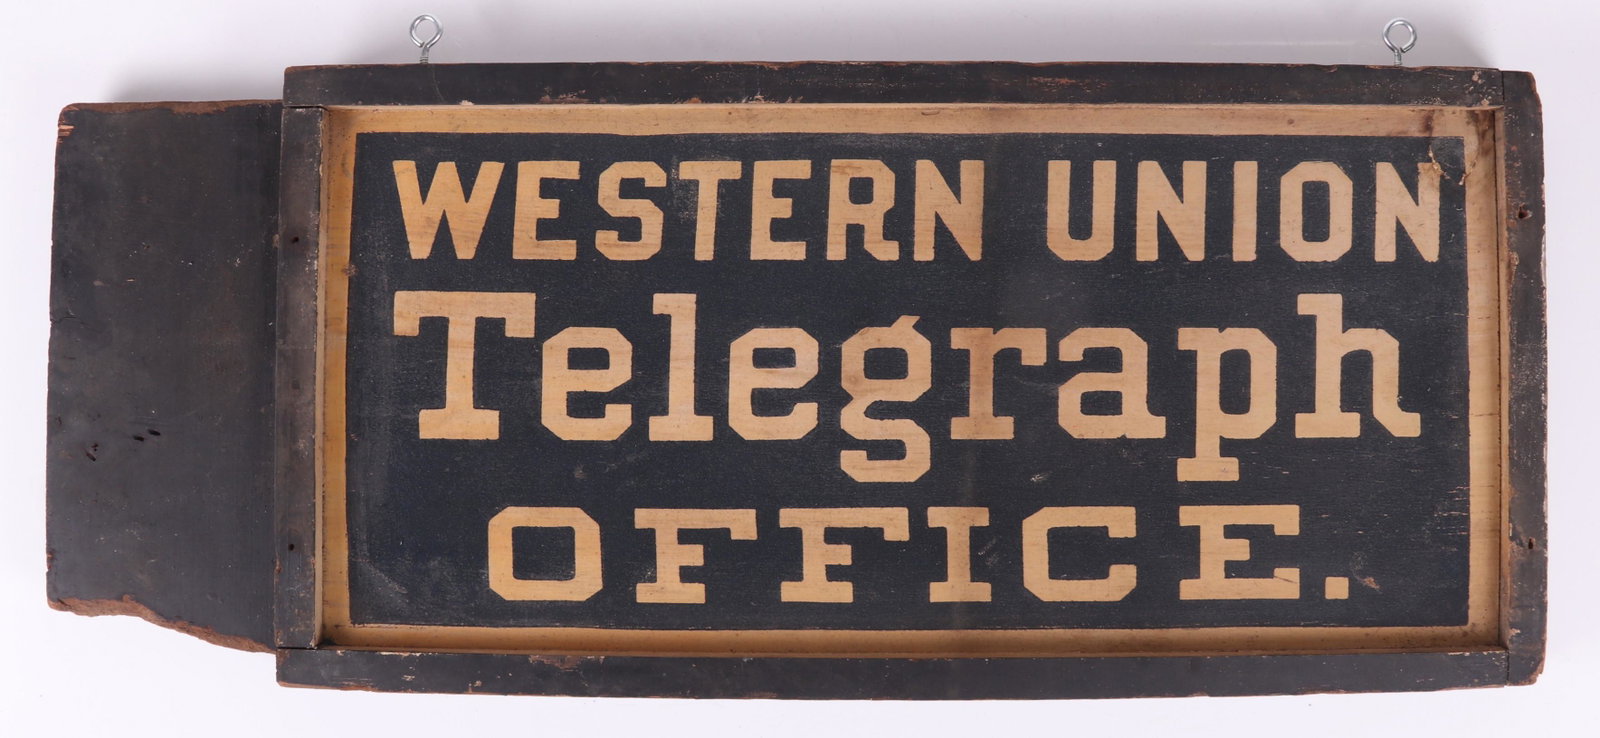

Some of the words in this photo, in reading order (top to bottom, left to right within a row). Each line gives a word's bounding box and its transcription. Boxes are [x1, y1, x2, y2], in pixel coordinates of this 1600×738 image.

[393, 160, 985, 261] WESTERN
[1047, 160, 1442, 262] UNION
[393, 291, 1421, 482] Telegraph
[488, 505, 1350, 603] OFFICE.
